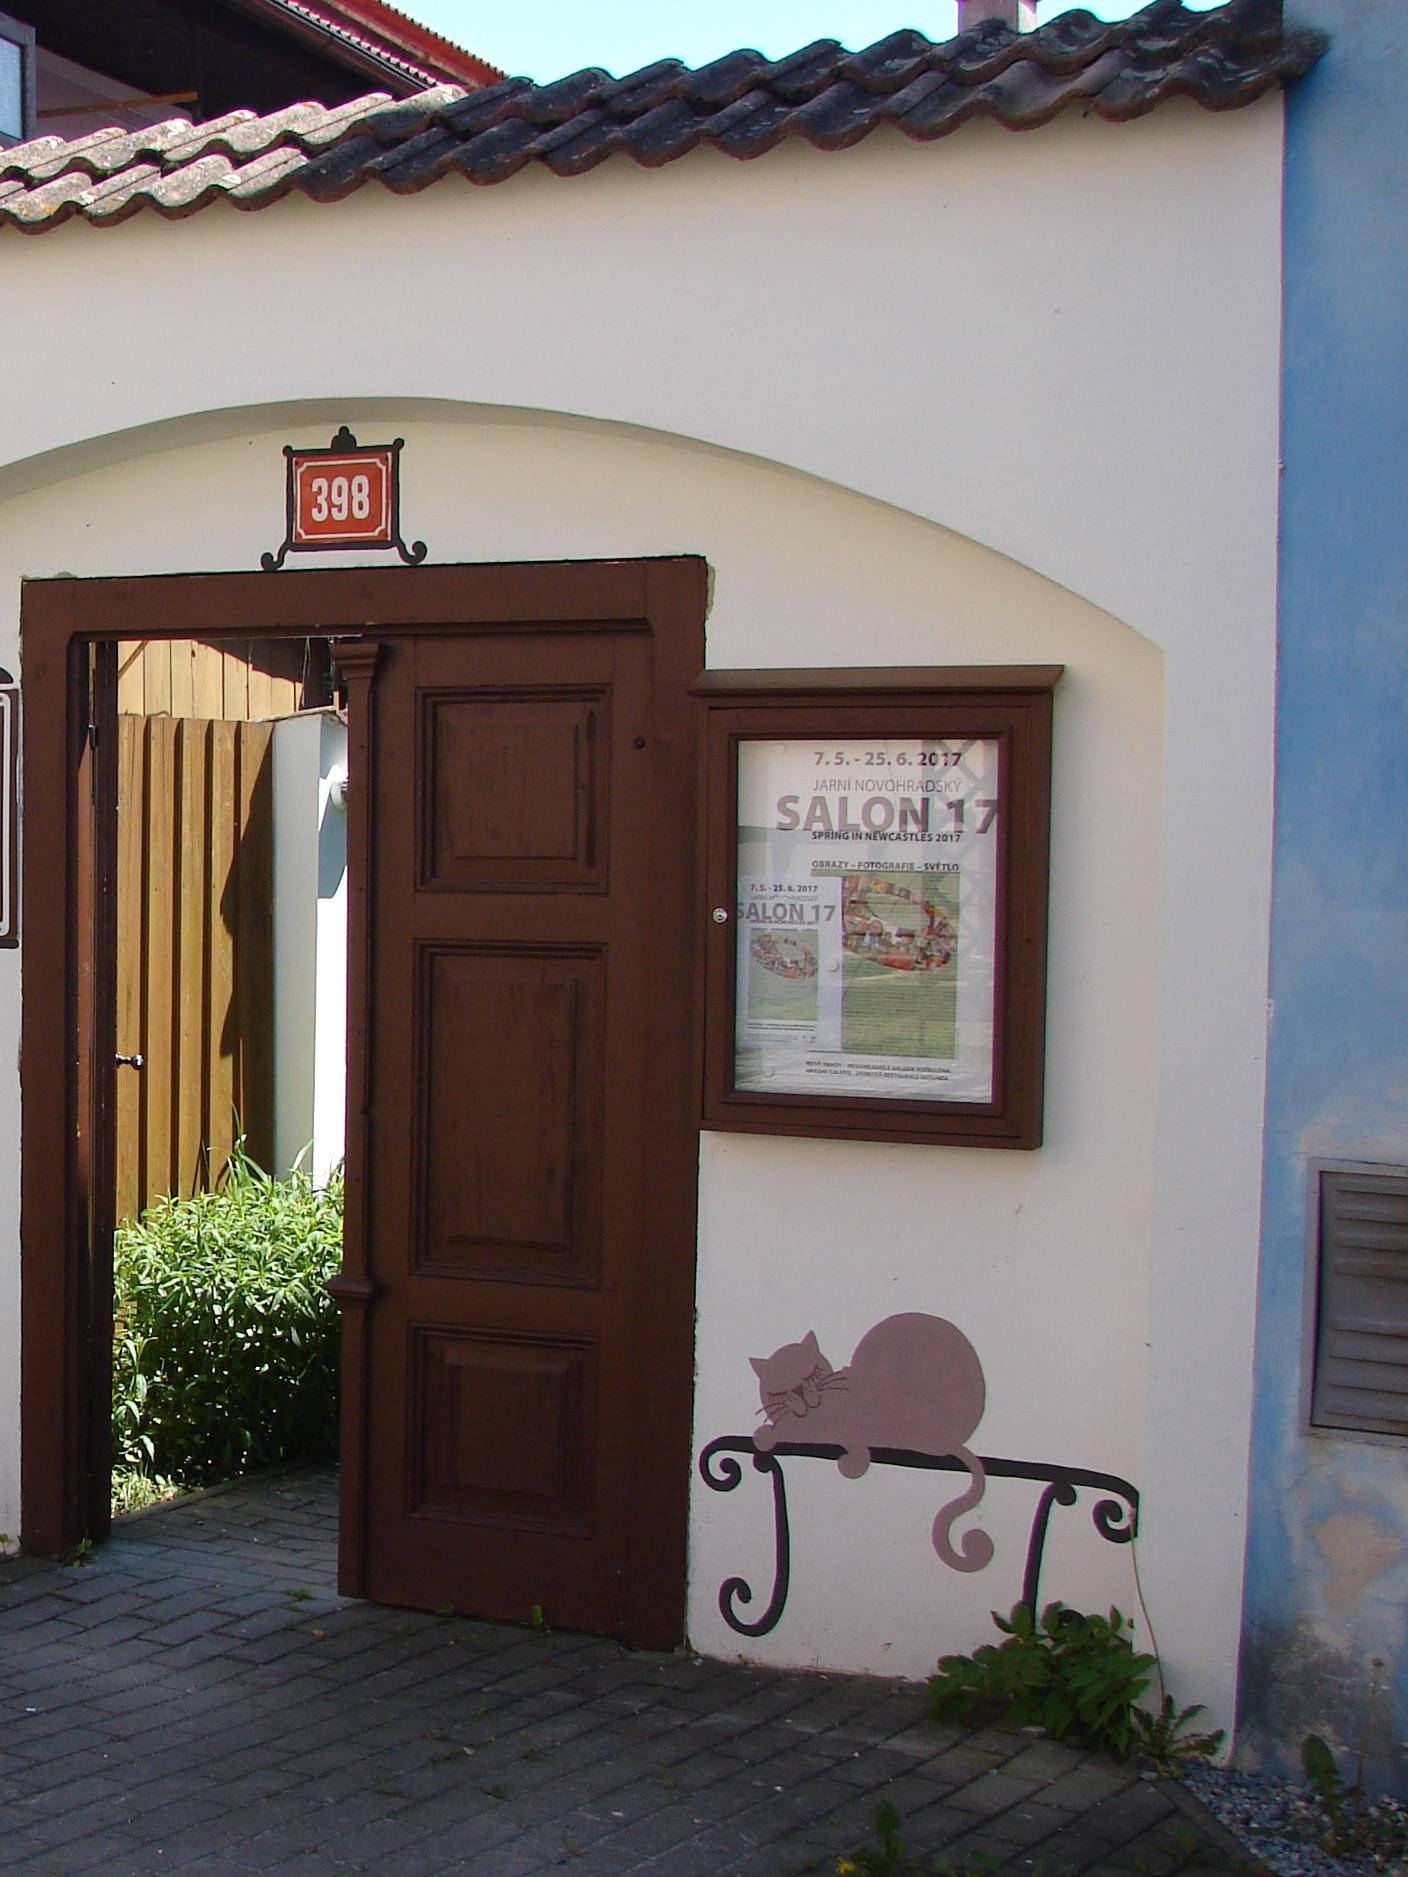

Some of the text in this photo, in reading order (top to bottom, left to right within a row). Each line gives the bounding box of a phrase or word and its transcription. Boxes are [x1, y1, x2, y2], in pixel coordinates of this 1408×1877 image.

[311, 467, 370, 522] 398
[864, 751, 892, 767] 25.
[896, 752, 913, 767] 6.
[917, 751, 962, 767] 2017
[813, 777, 963, 794] JARNÍ NOVOHRADSKÝ
[775, 795, 999, 835] SALON 17
[811, 830, 961, 843] SPRING IN NEWCASTLES 2017
[811, 859, 849, 869] OBRAZY
[857, 861, 917, 871] FOTOGRAFIE
[798, 885, 818, 894] 2017
[810, 904, 836, 923] 17
